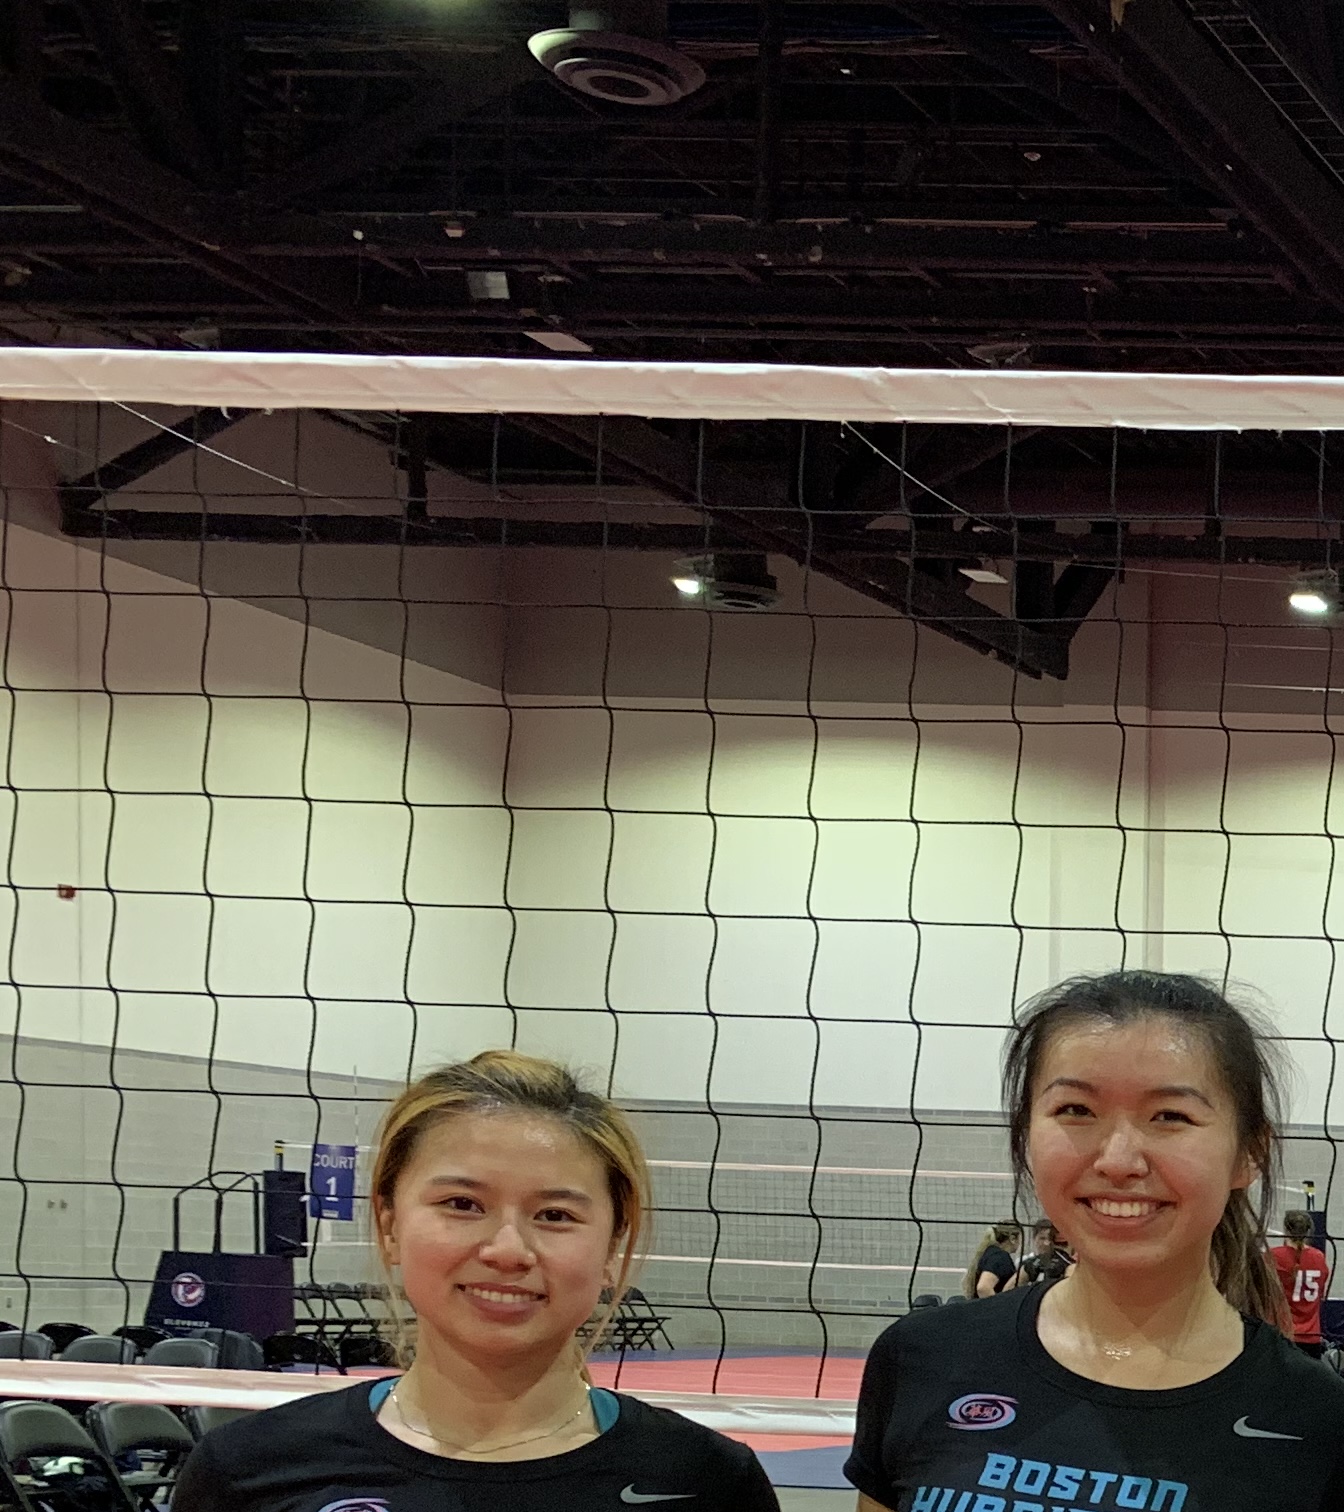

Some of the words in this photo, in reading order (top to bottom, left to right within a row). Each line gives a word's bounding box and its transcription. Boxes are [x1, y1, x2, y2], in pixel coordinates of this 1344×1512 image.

[314, 1153, 355, 1169] COURT
[325, 1176, 339, 1202] 1
[1292, 1270, 1321, 1302] 15
